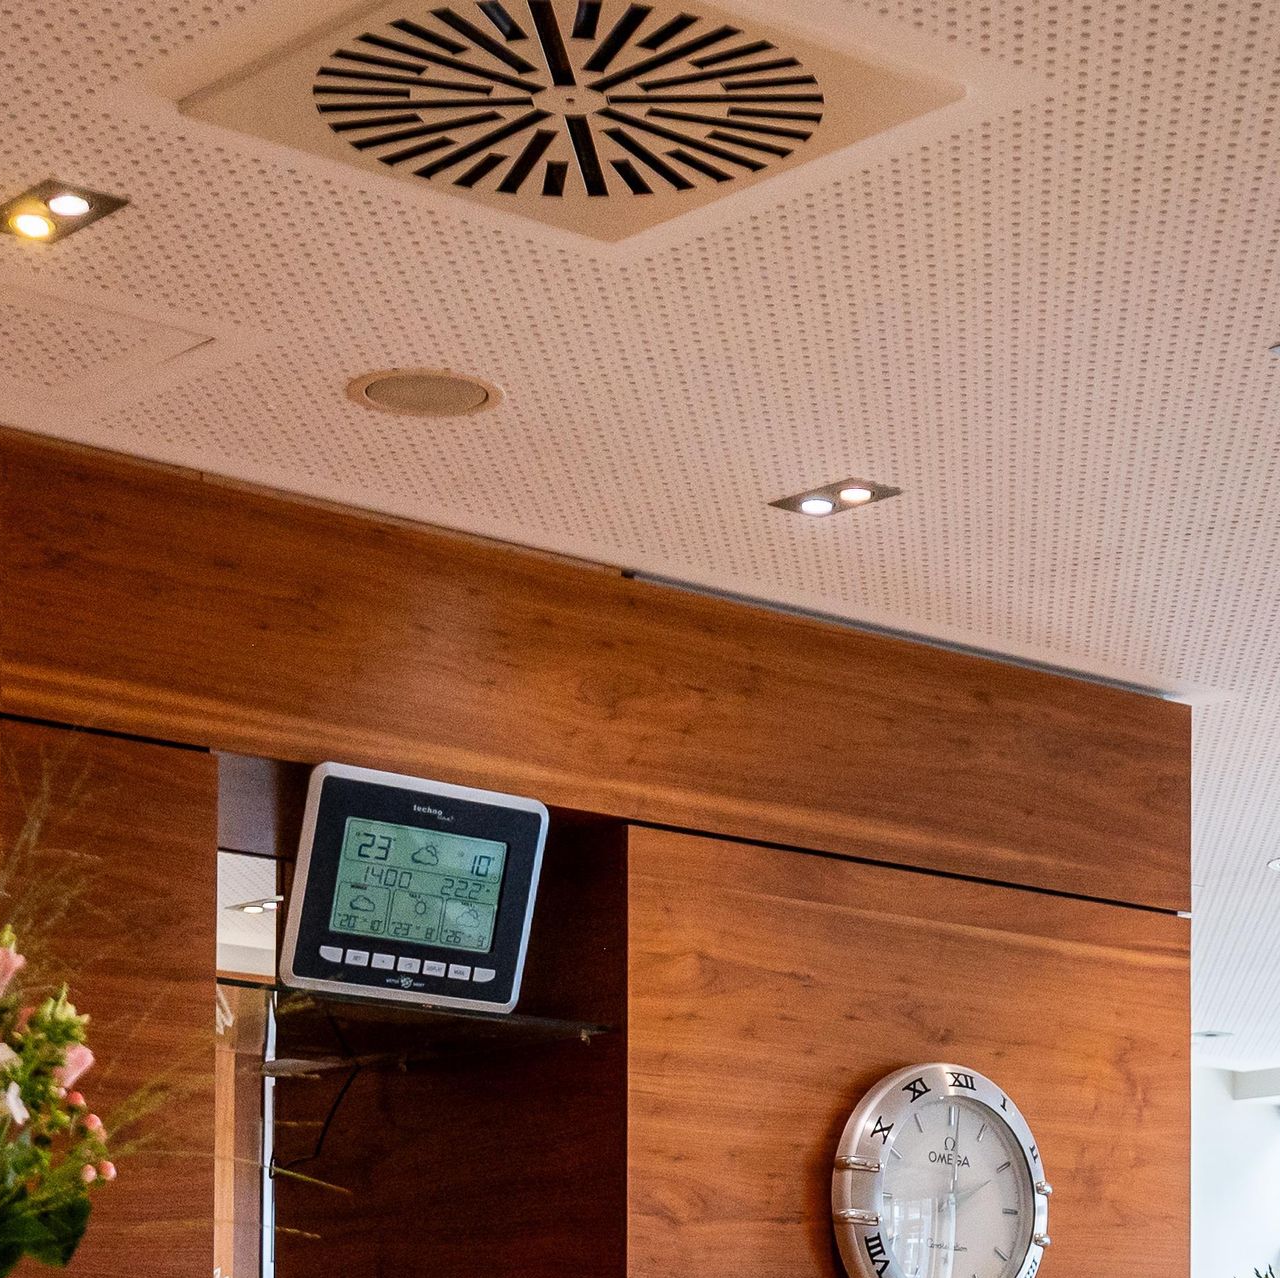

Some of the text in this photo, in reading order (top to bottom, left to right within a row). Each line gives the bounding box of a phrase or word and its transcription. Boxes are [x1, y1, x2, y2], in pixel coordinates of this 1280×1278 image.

[902, 1077, 931, 1103] XI
[946, 1072, 976, 1091] XII
[870, 1115, 894, 1145] X
